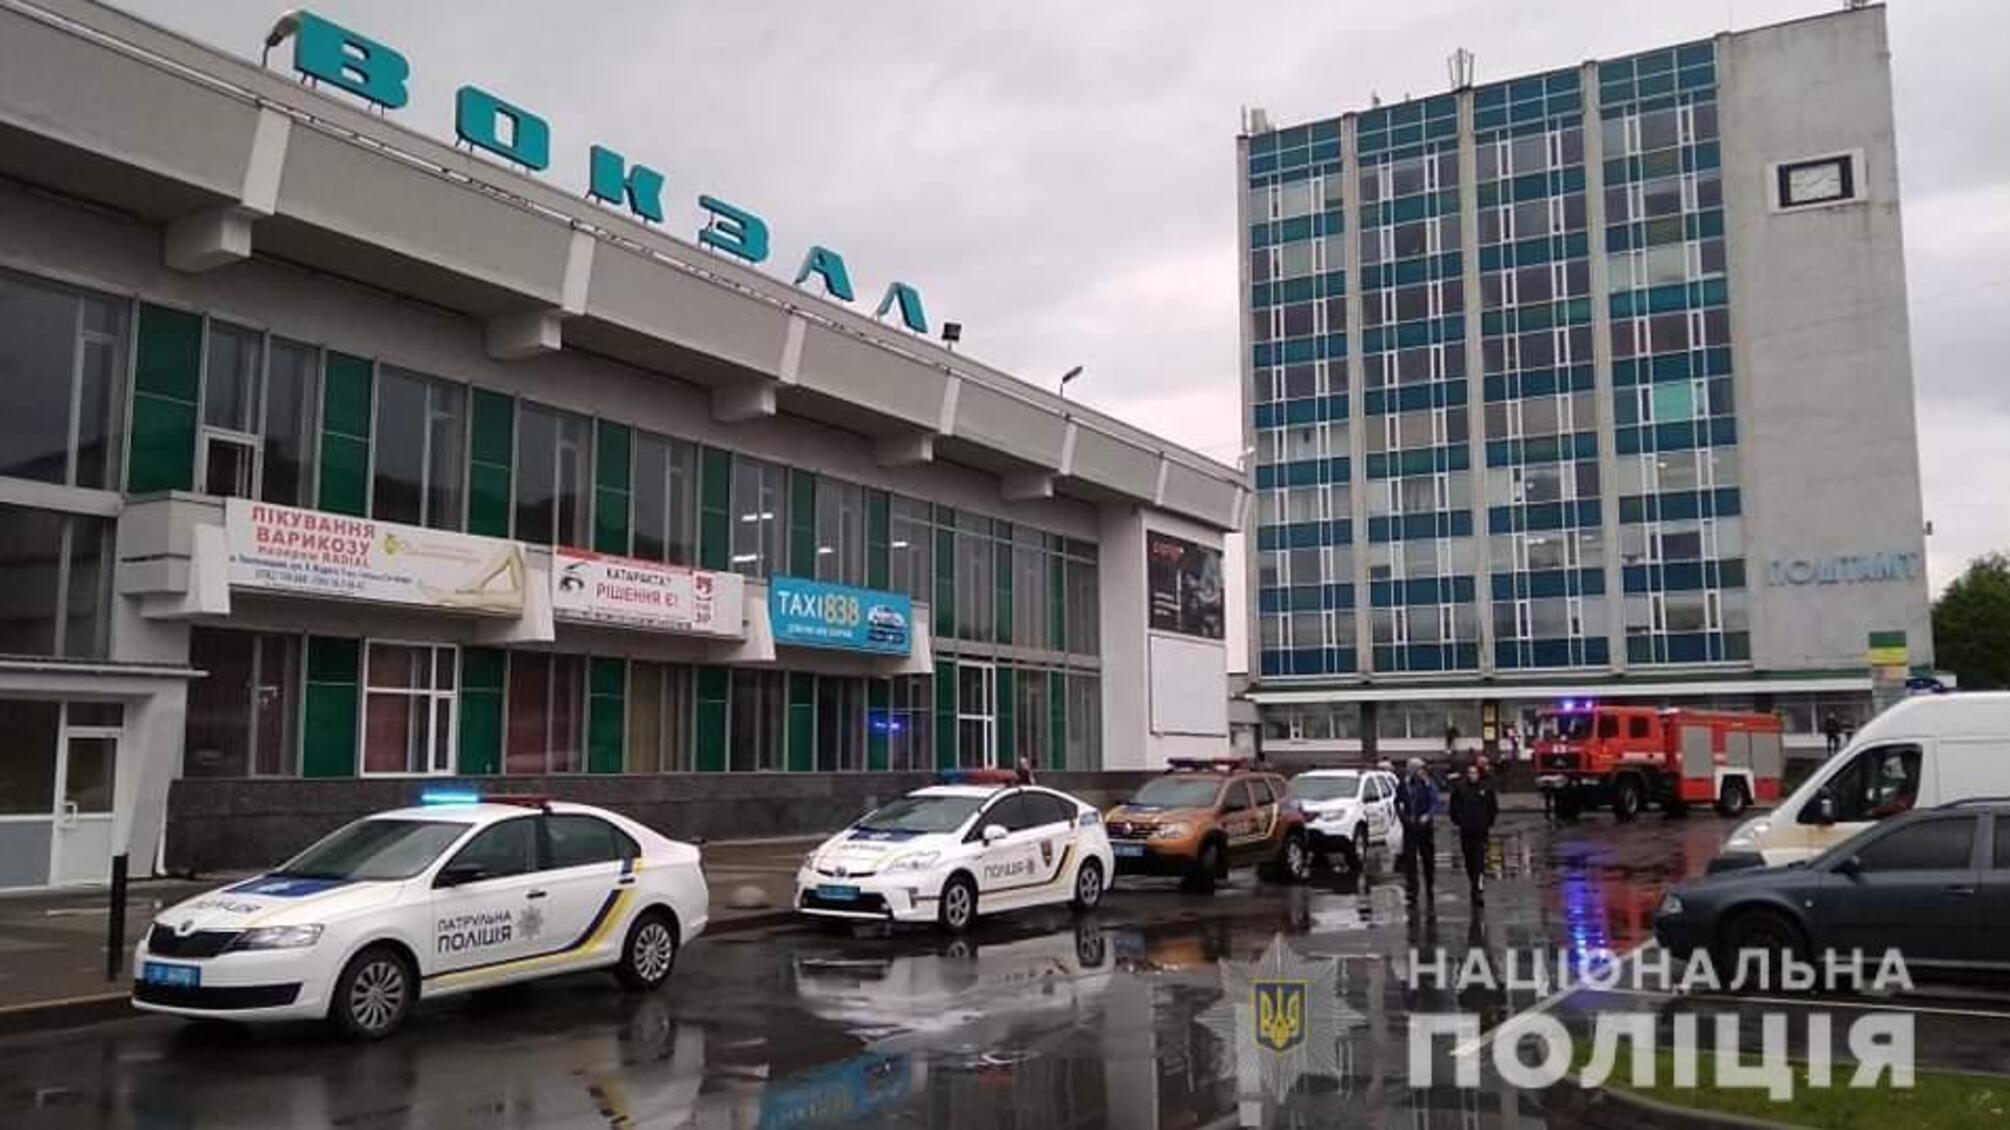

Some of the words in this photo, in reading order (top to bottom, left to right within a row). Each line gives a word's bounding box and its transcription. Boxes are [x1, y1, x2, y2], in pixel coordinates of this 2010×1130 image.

[294, 10, 929, 334] ВОКЗАЛ
[256, 526, 371, 556] ВАРИКОЗУ
[596, 583, 662, 604] РІШЕННЯ
[438, 924, 512, 953] ПОЛІЦІЯ
